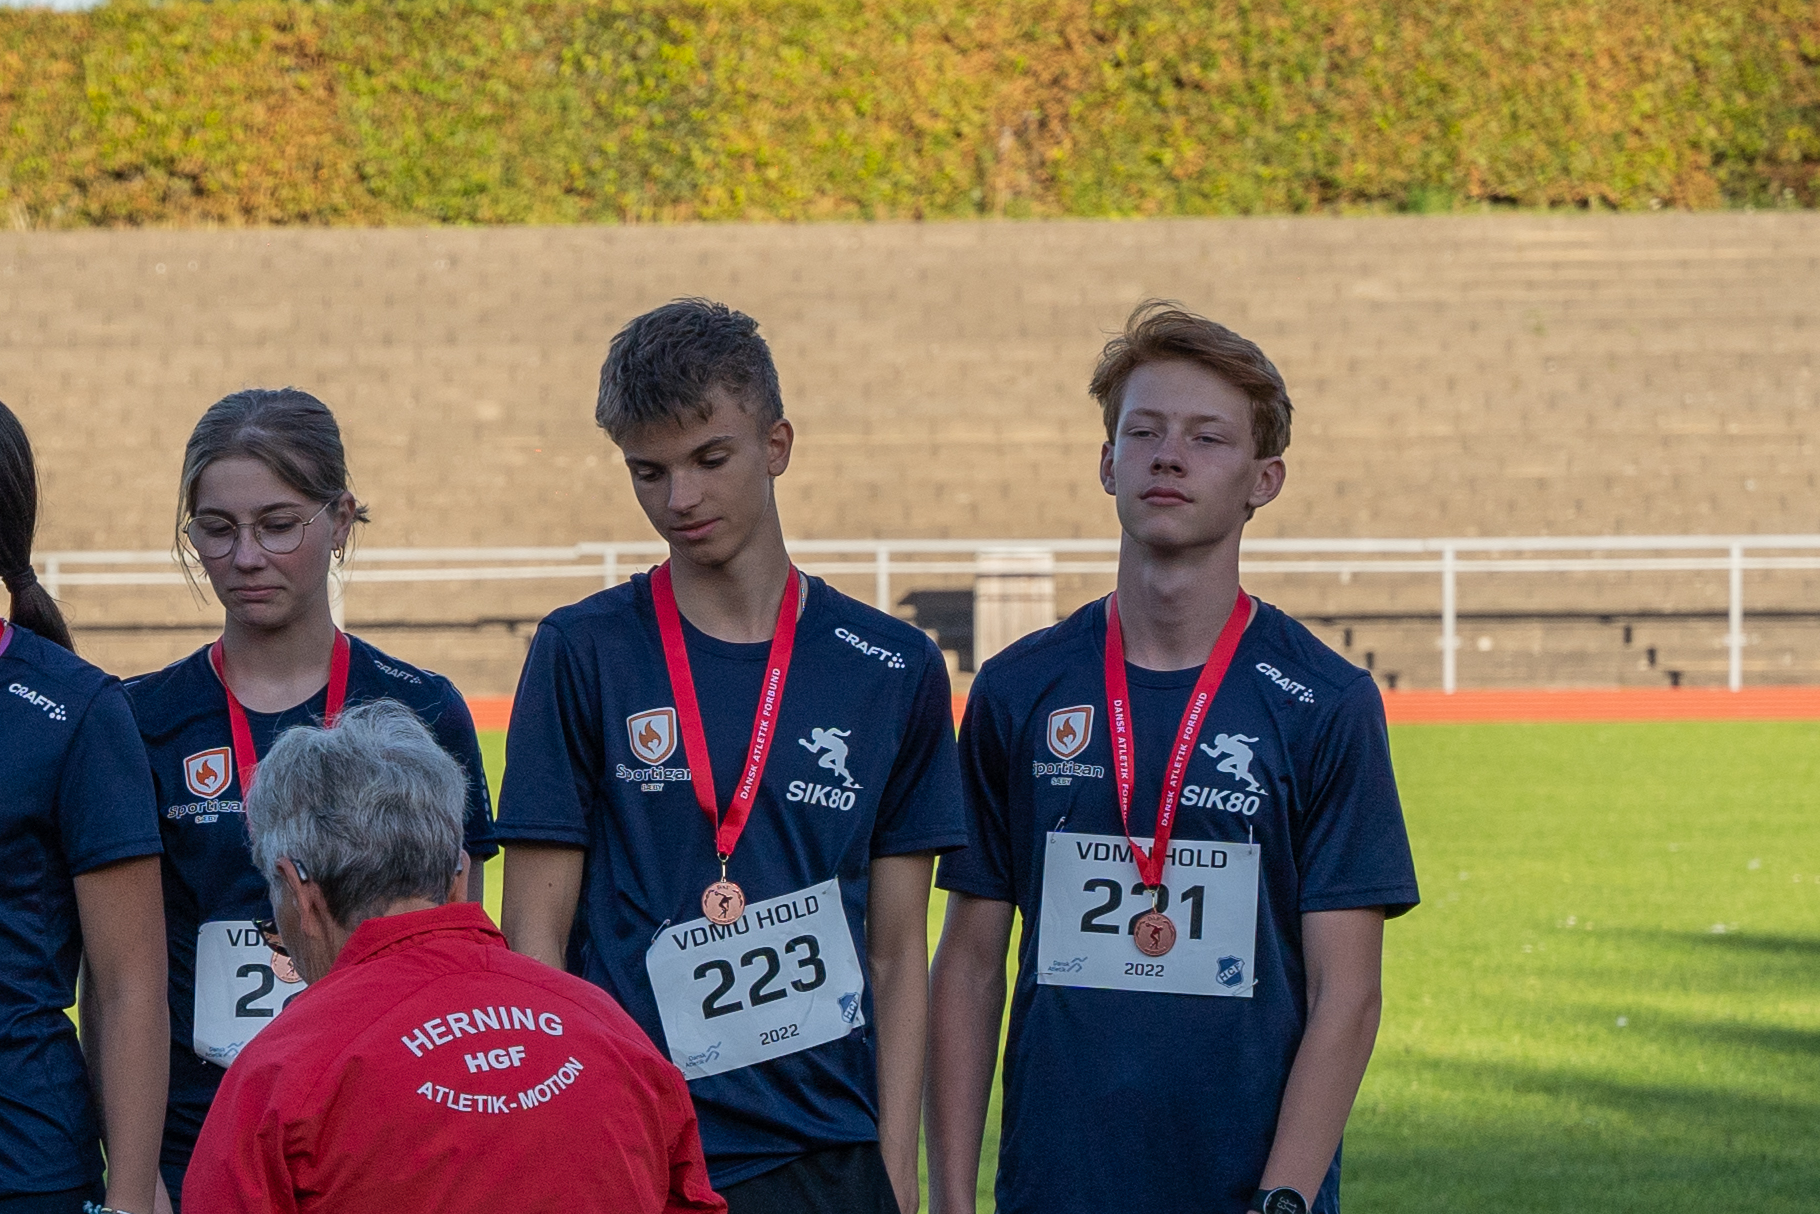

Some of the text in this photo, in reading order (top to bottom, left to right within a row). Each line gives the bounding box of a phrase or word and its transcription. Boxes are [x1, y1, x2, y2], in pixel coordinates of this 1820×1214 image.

[834, 627, 893, 661] CRAFT
[373, 659, 413, 682] CRAFT
[1255, 661, 1306, 696] CRAFT
[7, 682, 56, 713] CRAFT
[1113, 699, 1126, 734] DANSK
[740, 667, 781, 800] DANSK ATLETIK FORBUND
[1117, 736, 1129, 780] ATLETIK
[1160, 691, 1208, 827] DANSK ATLETIK FORBUND
[166, 798, 246, 819] Sportiga
[786, 780, 856, 811] SIK80
[1180, 784, 1261, 816] SIK80
[1076, 841, 1154, 863] VDM
[672, 895, 820, 951] VDMU HOLD
[1080, 877, 1206, 941] 221
[226, 928, 269, 947] VD
[693, 934, 827, 1020] 223
[1123, 962, 1165, 978] 2022
[401, 1006, 564, 1058] HERNING
[759, 1023, 800, 1046] 2022
[464, 1045, 526, 1074] HGF
